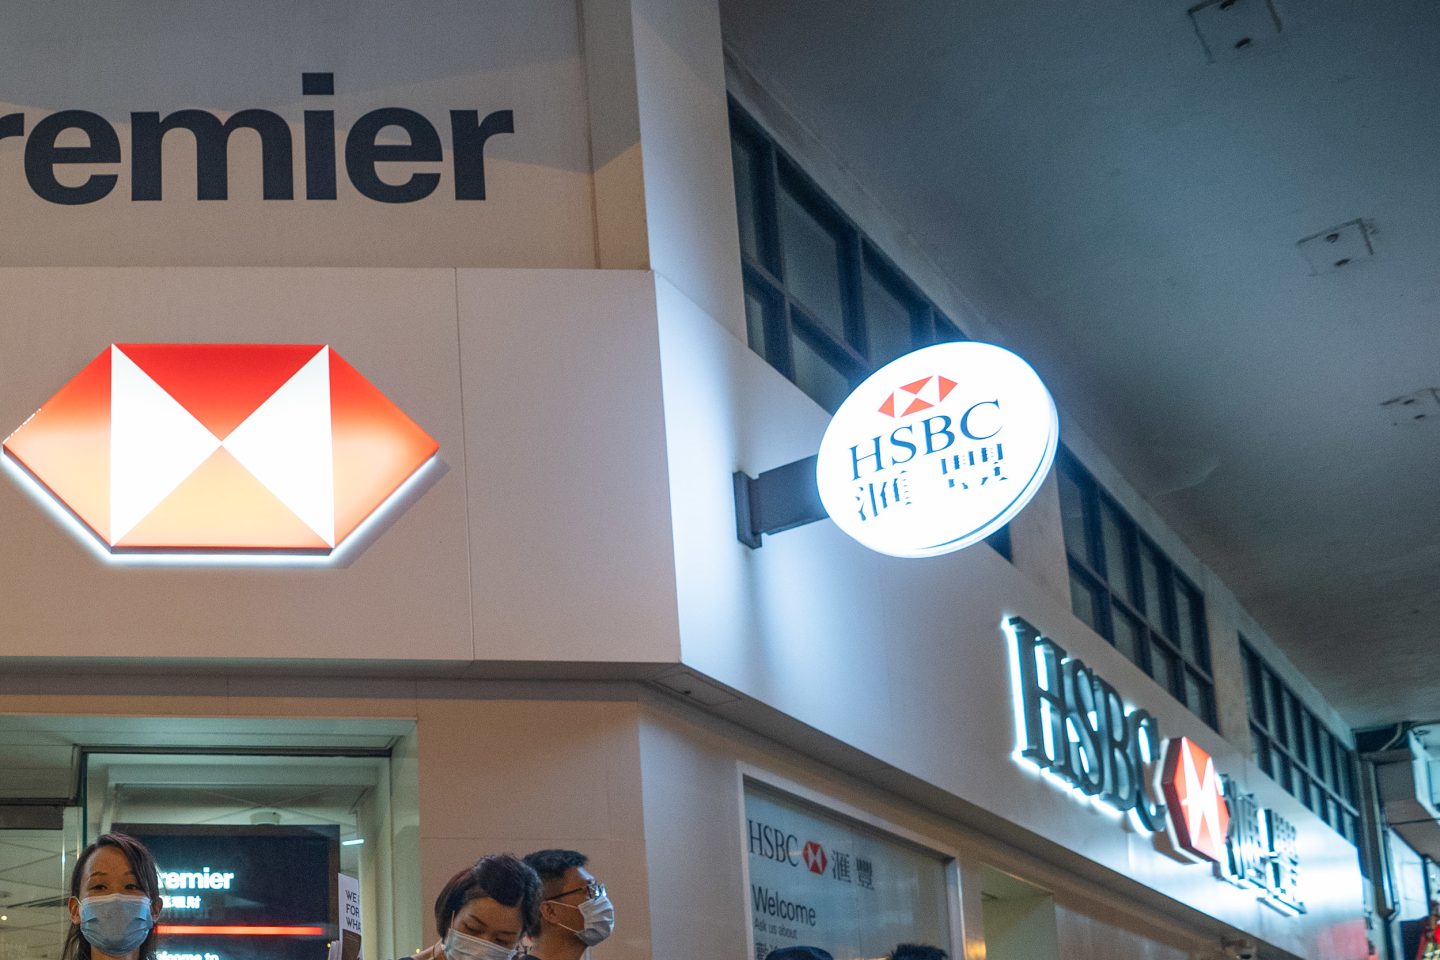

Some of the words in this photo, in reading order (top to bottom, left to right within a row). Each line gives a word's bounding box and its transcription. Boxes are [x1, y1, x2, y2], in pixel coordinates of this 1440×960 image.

[849, 398, 1003, 482] HSBC
[1002, 615, 1166, 838] HSBC
[748, 820, 799, 867] HSBC
[158, 867, 235, 889] remier
[345, 890, 357, 903] WE
[752, 884, 816, 926] Welcome
[346, 917, 362, 931] WHA
[768, 923, 778, 934] us
